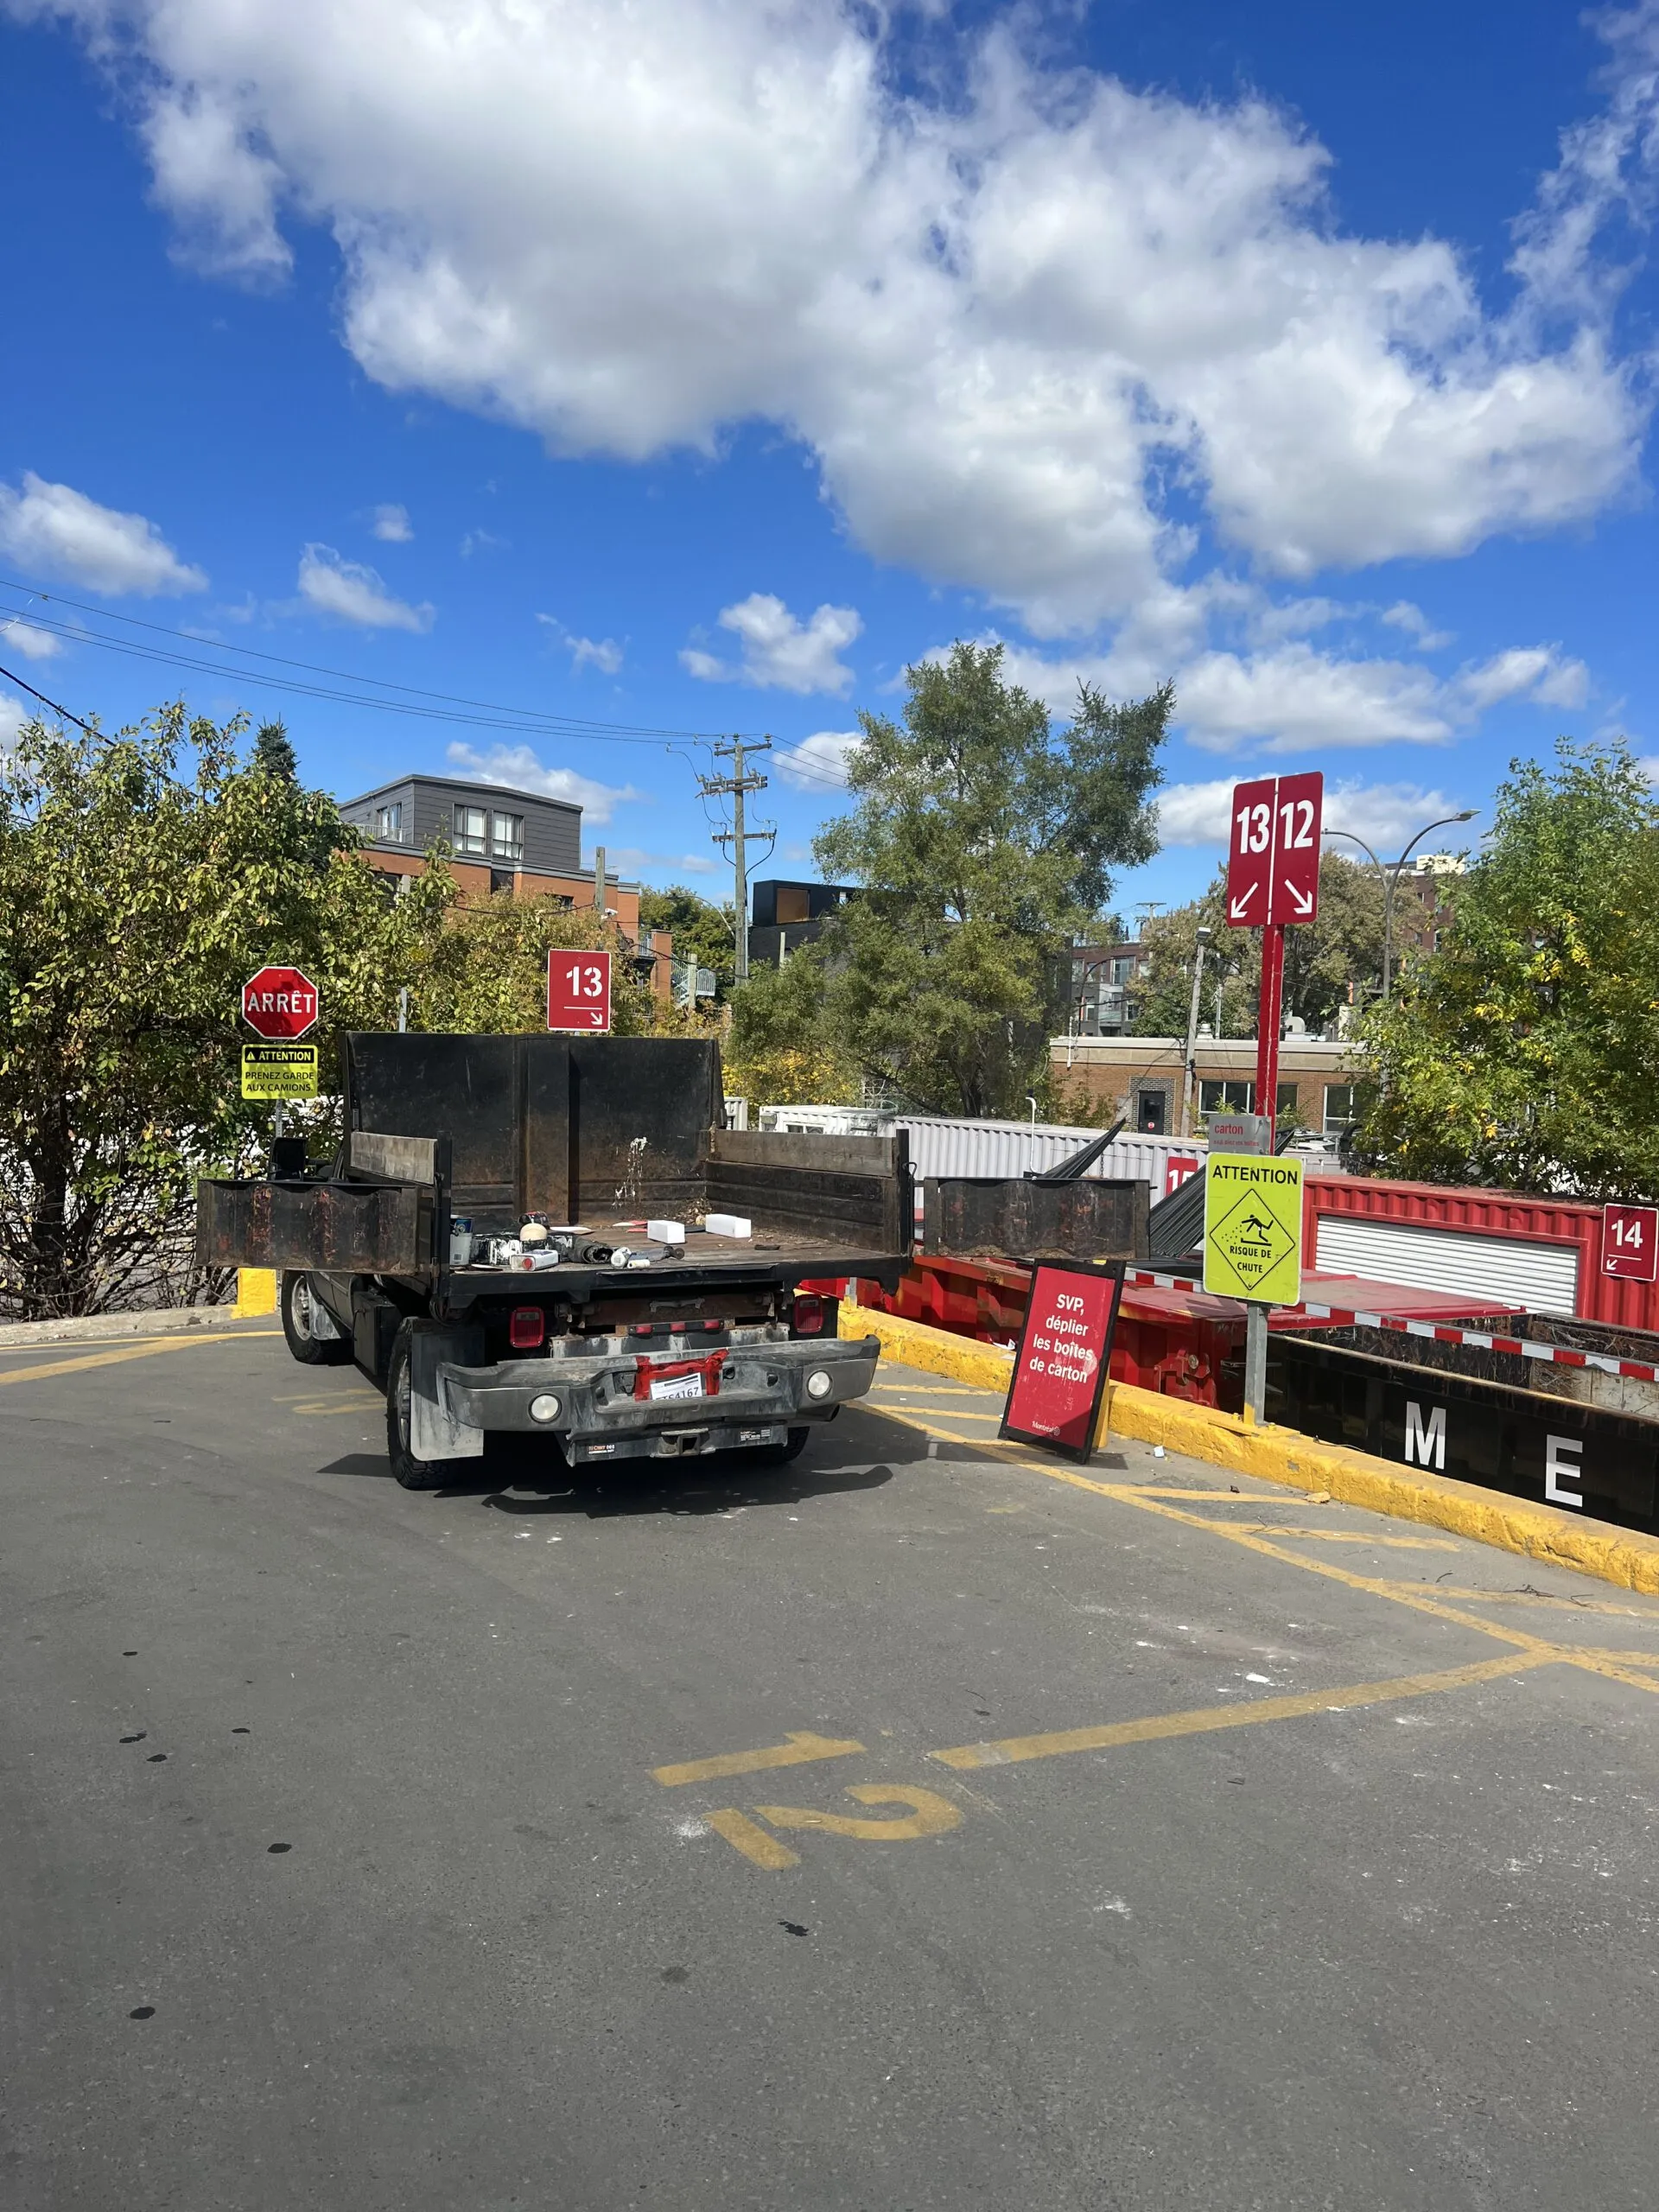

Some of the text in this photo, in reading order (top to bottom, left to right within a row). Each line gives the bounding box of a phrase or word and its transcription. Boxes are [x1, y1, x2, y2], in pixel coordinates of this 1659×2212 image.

[1236, 803, 1270, 855] 13
[1280, 799, 1314, 849] 12
[566, 966, 603, 997] 13
[247, 989, 314, 1014] ARRÊT
[258, 1051, 311, 1061] ATTENTION
[245, 1071, 314, 1080] PRENEZ GARDE
[1214, 1124, 1243, 1135] carton
[1212, 1165, 1298, 1185] ATTENTION
[1611, 1219, 1643, 1249] 14
[1230, 1245, 1272, 1258] RISQUE DE
[1236, 1262, 1262, 1274] CHUTE
[1056, 1294, 1084, 1316] SVP,
[1046, 1315, 1089, 1337] déplier
[1033, 1333, 1093, 1362] les boîtes
[1029, 1356, 1088, 1383] de carton
[1405, 1401, 1583, 1508] M E
